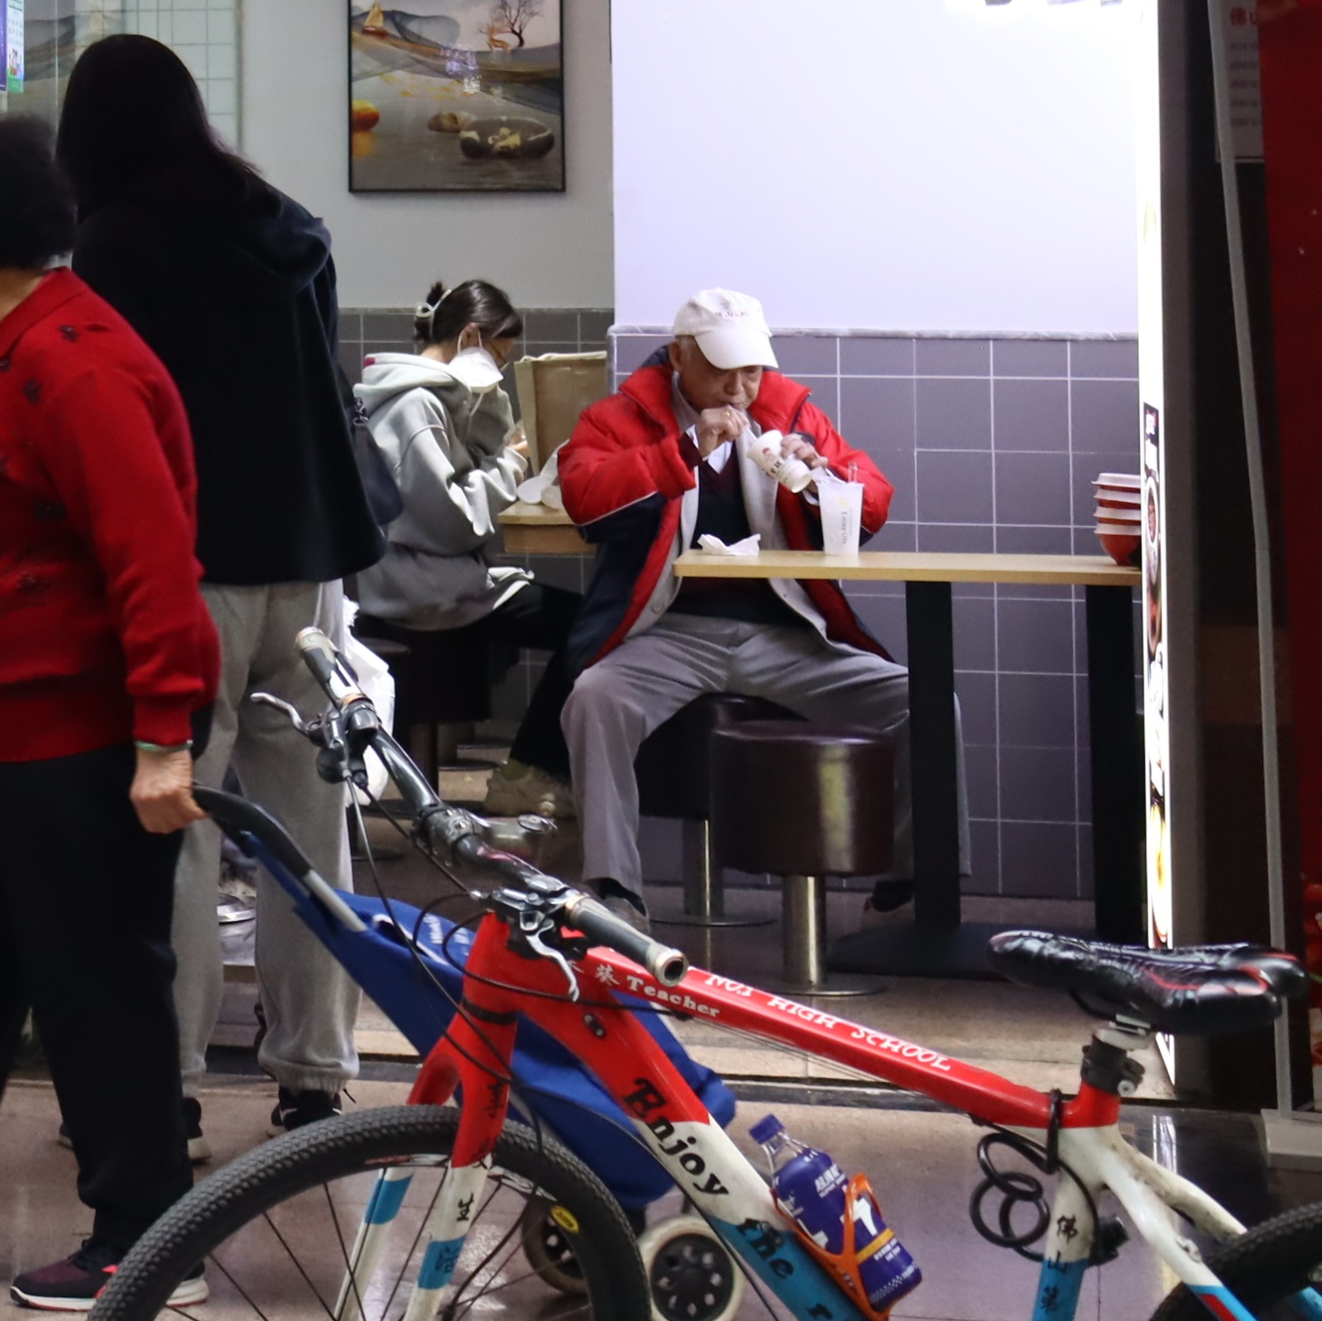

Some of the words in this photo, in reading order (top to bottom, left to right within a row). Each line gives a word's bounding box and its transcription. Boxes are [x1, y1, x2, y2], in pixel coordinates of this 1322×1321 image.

[627, 974, 720, 1017] Teacher
[767, 997, 848, 1030] HIGH
[851, 1026, 953, 1072] SCHOOL
[622, 1078, 729, 1198] Enjoy
